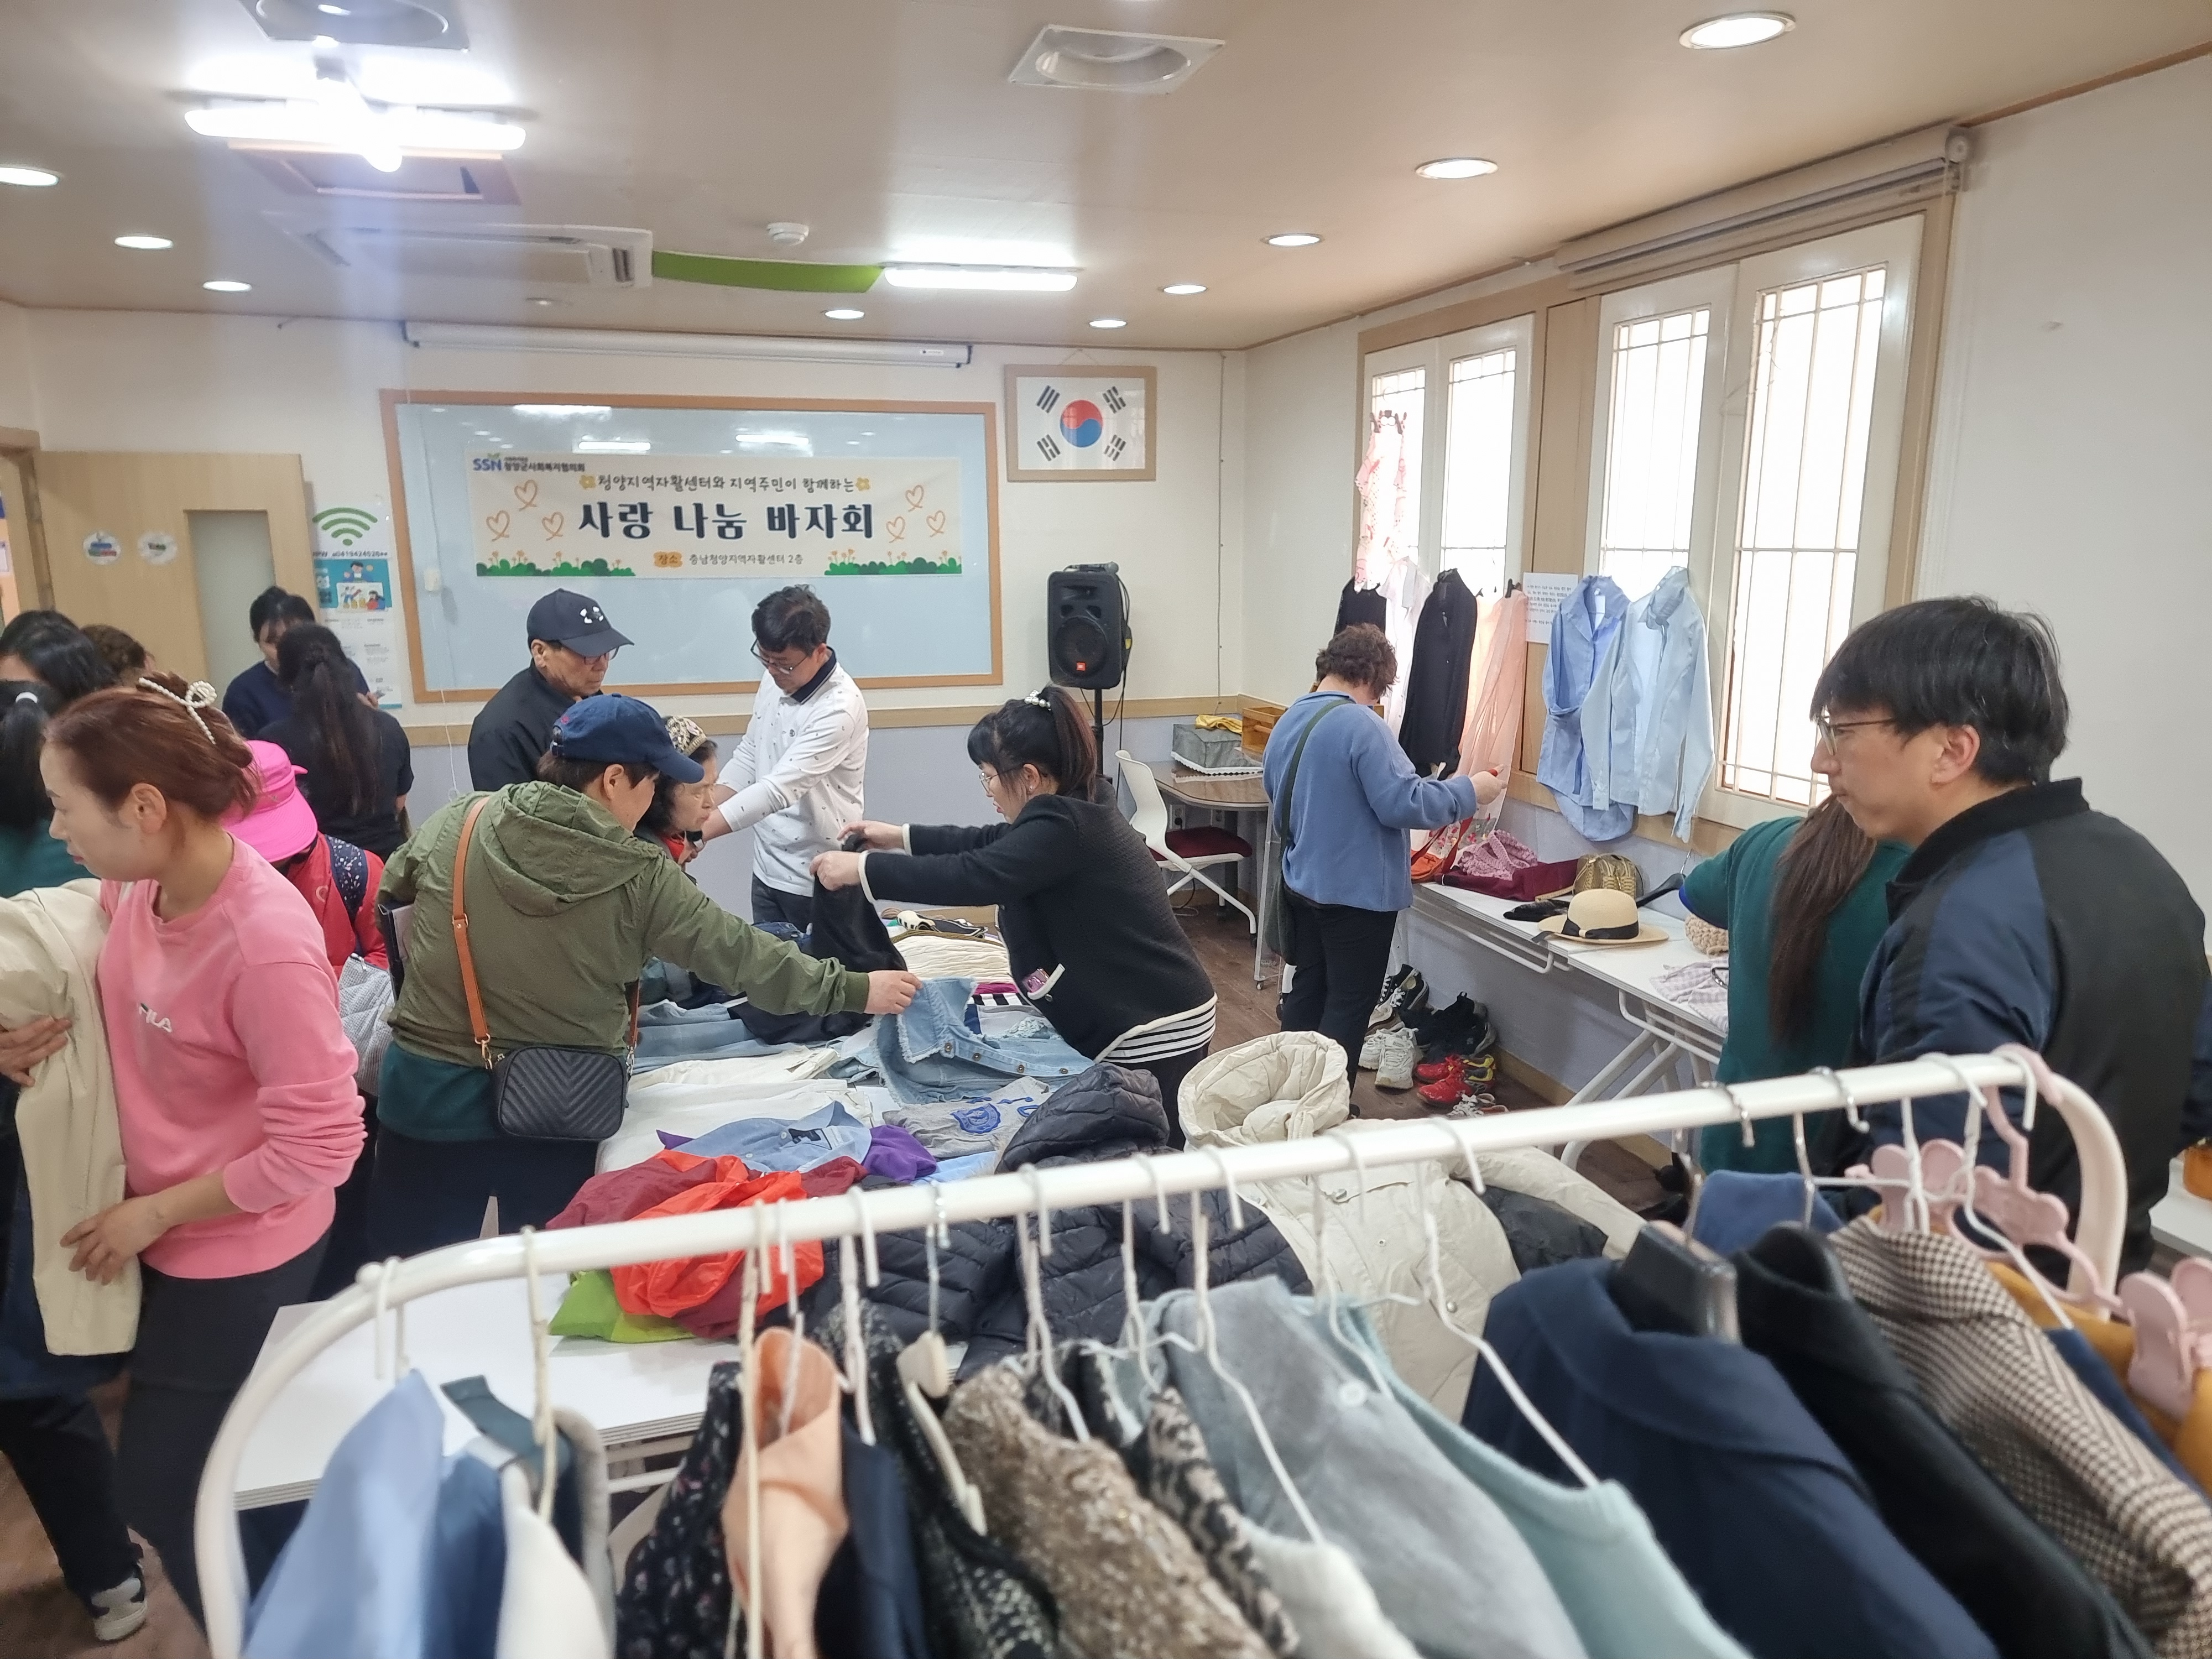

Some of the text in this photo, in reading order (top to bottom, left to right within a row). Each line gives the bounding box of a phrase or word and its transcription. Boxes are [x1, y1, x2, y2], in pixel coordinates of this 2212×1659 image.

[473, 457, 502, 471] SSN
[598, 474, 854, 493] 청양지역자활센터와 지역주민이 함께하는
[578, 501, 873, 540] 사랑 나눔 바자회
[659, 554, 679, 565] 장소
[787, 554, 804, 565] 2층
[138, 1003, 173, 1033] FILA
